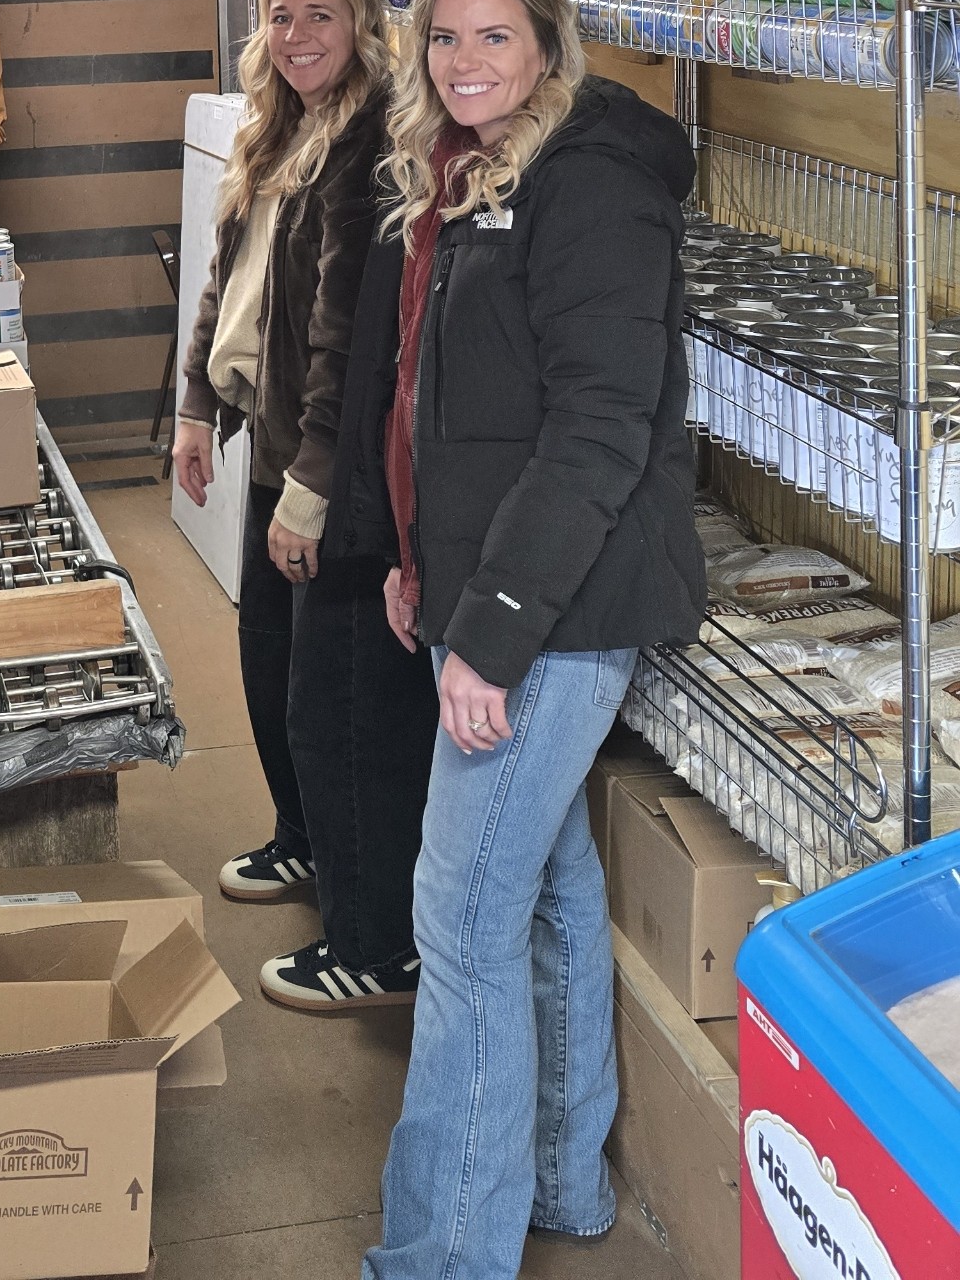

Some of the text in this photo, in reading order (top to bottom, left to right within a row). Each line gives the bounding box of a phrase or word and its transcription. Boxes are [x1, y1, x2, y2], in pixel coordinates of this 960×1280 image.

[477, 220, 497, 230] FACE
[756, 601, 834, 624] SUPREME
[752, 1008, 773, 1035] AHT
[16, 1135, 59, 1152] MOUNTAIN
[31, 1152, 80, 1172] FACTORY
[42, 1204, 69, 1216] WITH
[72, 1202, 102, 1214] CARE
